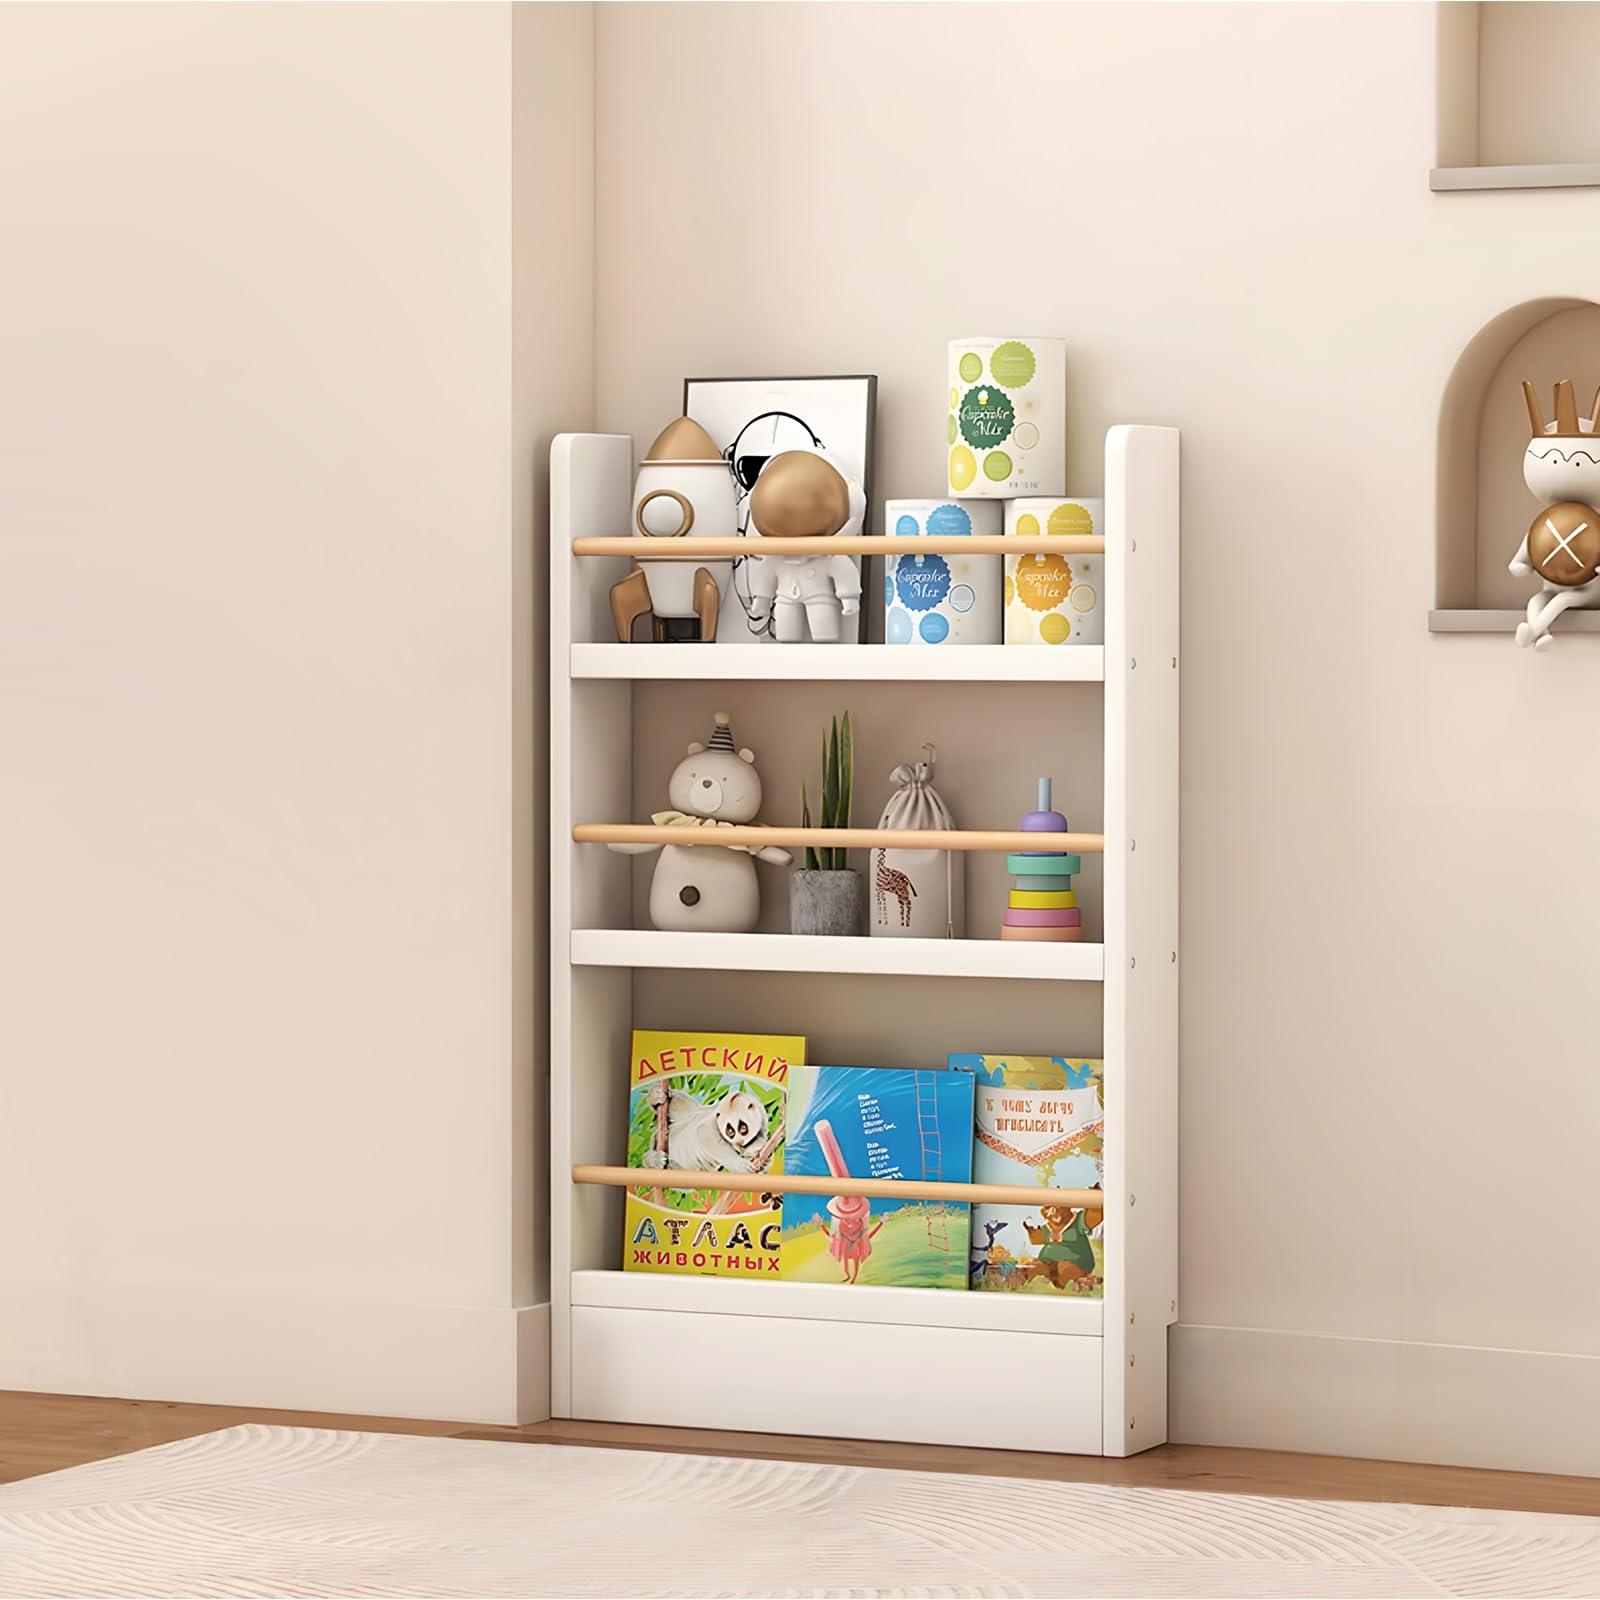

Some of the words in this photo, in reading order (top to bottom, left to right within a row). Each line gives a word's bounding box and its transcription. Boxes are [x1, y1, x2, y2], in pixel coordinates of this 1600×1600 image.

[637, 1046, 789, 1083] ДЕТСКИЙ
[632, 1216, 781, 1251] АТЛАС
[633, 1250, 780, 1271] ЖИВОТНЫХ
